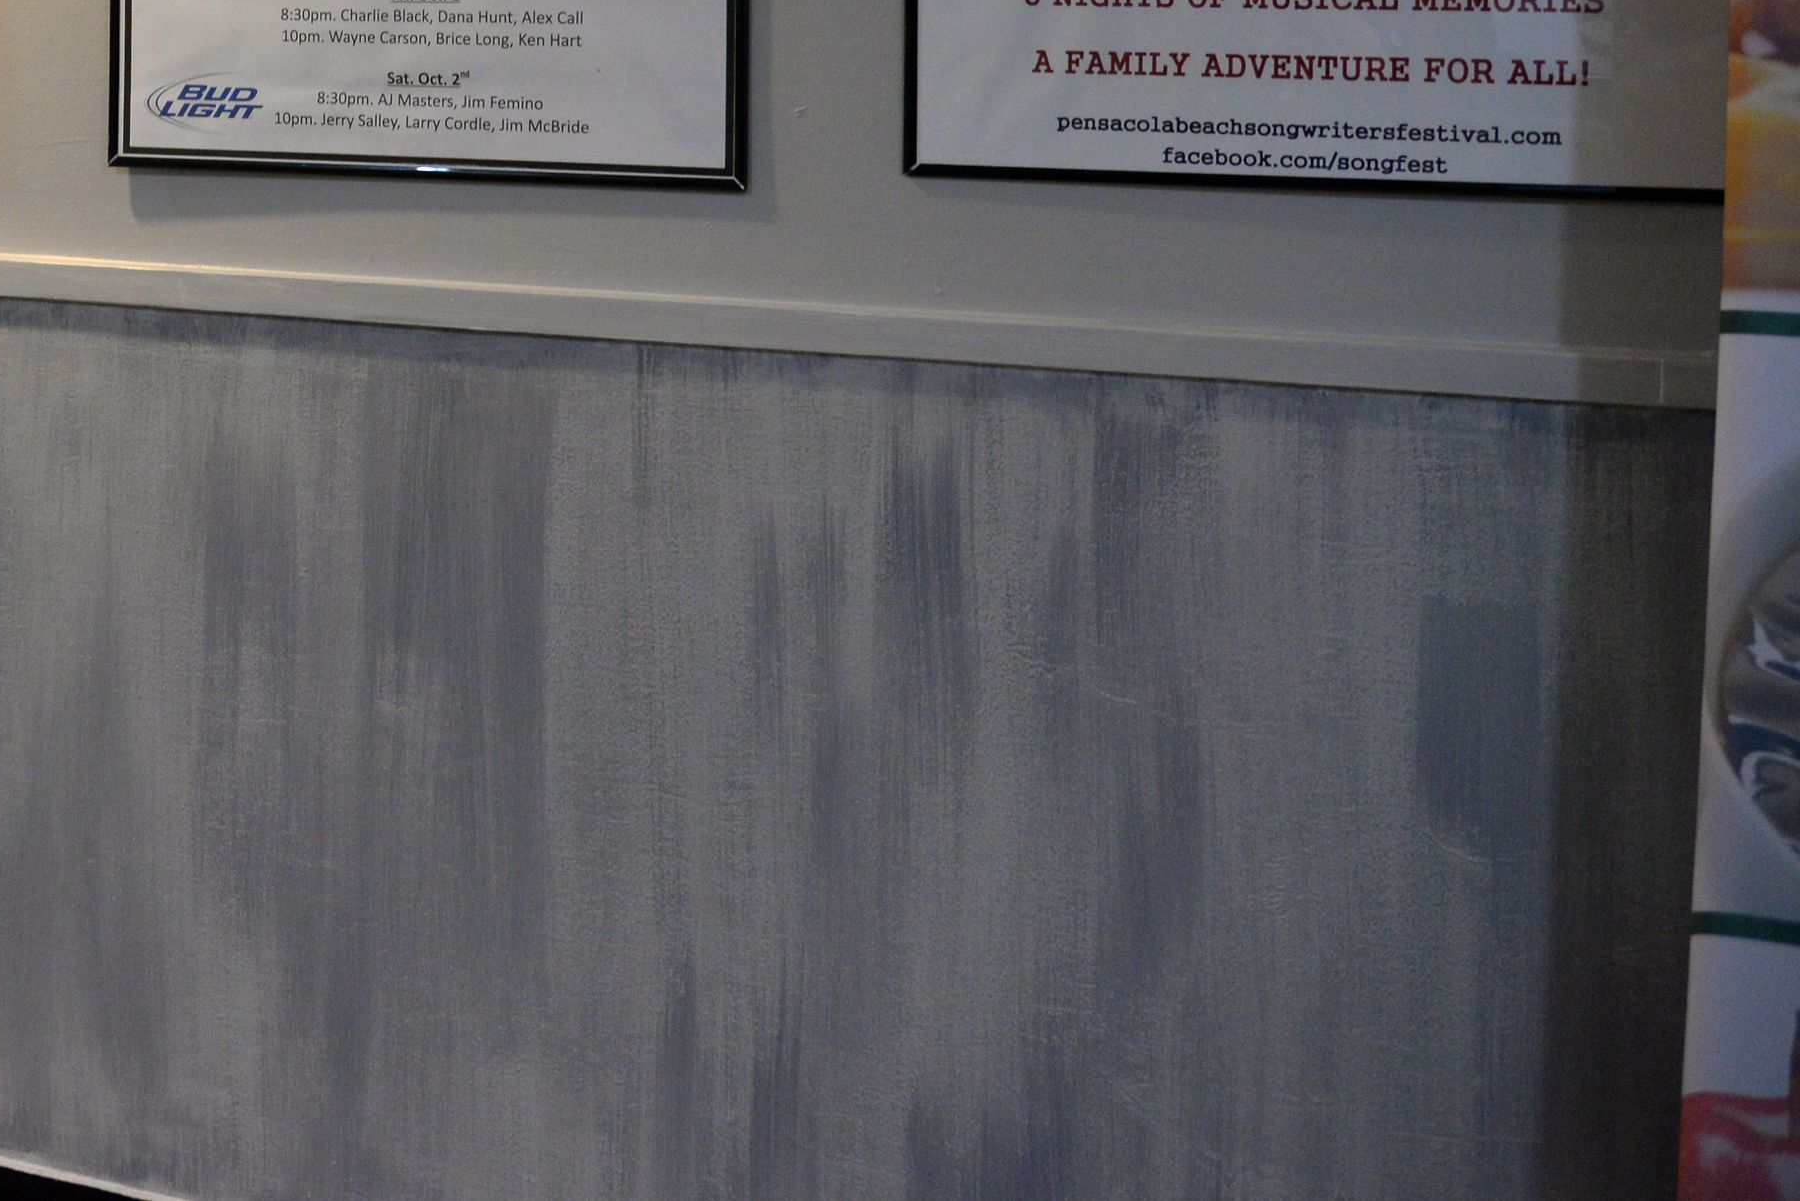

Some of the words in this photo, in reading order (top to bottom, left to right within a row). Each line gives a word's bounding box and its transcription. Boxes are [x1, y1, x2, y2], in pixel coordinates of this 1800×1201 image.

[279, 6, 336, 25] 8:30pm.
[340, 7, 389, 22] Charlie
[392, 7, 433, 25] Black,
[437, 9, 473, 23] Dana
[478, 9, 517, 26] Hunt,
[520, 9, 552, 24] Alex
[556, 10, 583, 25] Call
[281, 29, 324, 45] 10pm.
[327, 29, 376, 46] Wayne
[379, 30, 431, 47] Carson,
[435, 30, 471, 45] Brice
[475, 31, 514, 50] Long,
[517, 32, 545, 47] Ken
[549, 32, 581, 47] Hart
[1031, 48, 1054, 74] A
[1064, 49, 1190, 77] FAMILY
[1200, 52, 1410, 82] ADVENTURE
[1422, 56, 1495, 84] FOR
[1506, 58, 1589, 87] ALL!
[386, 71, 414, 85] Sat.
[417, 71, 448, 86] Oct.
[177, 84, 258, 101] BUD
[316, 90, 373, 108] 8:30pm.
[376, 92, 393, 106] AJ
[397, 92, 457, 110] Masters,
[460, 94, 485, 108] Jim
[489, 95, 543, 110] Femino
[160, 100, 263, 119] LIGHT
[274, 110, 317, 128] 10pm.
[319, 112, 355, 129] Jerry
[357, 112, 400, 131] Salley,
[405, 114, 441, 132] Larry
[444, 115, 495, 133] Cordle,
[498, 117, 523, 132] Jim
[527, 118, 589, 134] McBride
[1056, 115, 1562, 146] pensacolabeachsongwritersfestival.com
[1162, 146, 1448, 175] facebook.com/songfest
